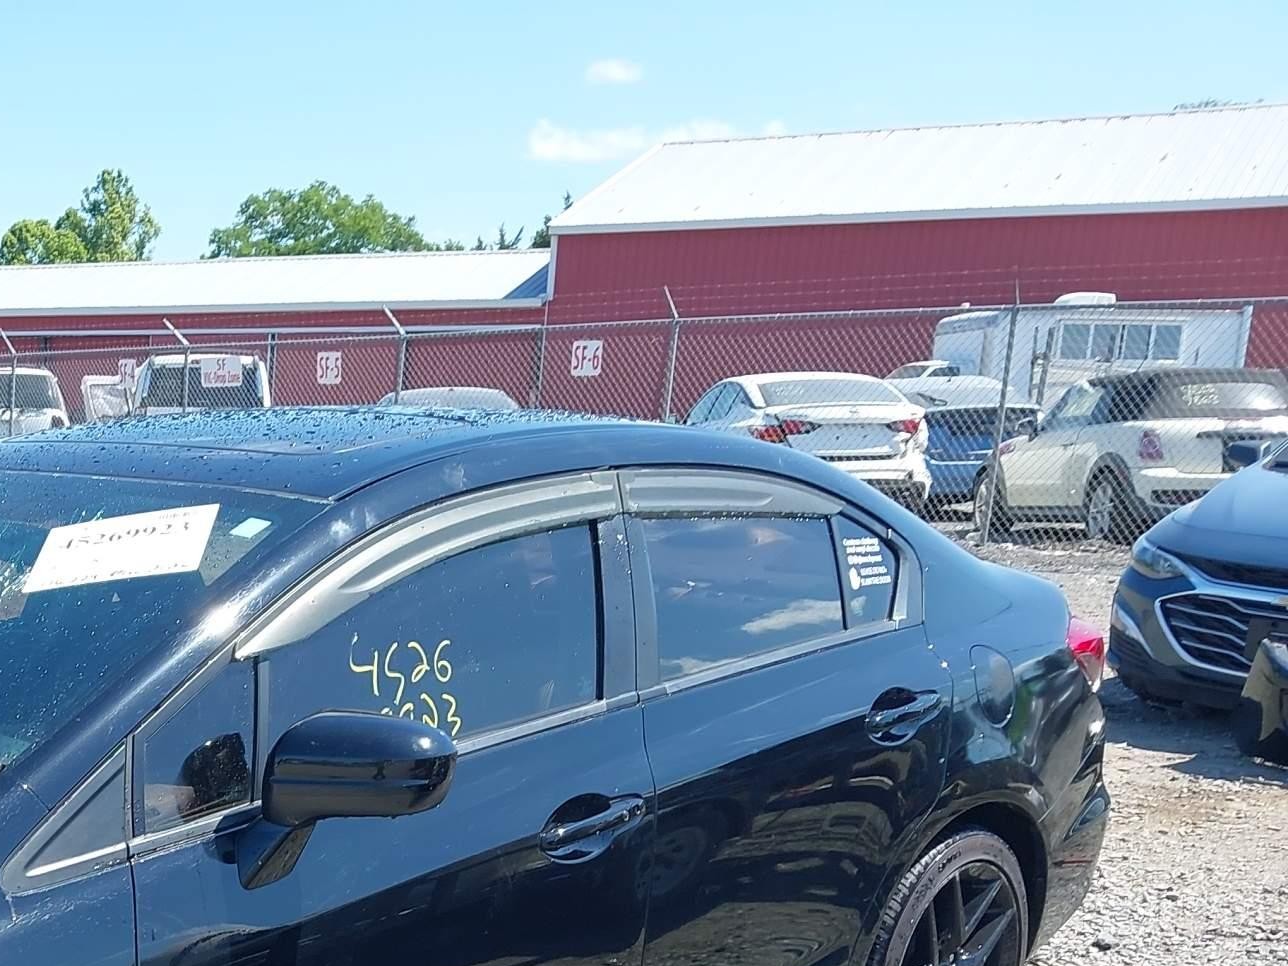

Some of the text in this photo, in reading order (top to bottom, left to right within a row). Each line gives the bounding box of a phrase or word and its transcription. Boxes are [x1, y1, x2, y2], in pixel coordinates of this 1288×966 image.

[216, 358, 226, 371] SF
[319, 356, 339, 378] SF-5
[573, 345, 599, 370] SF-6
[349, 632, 452, 705] 4526
